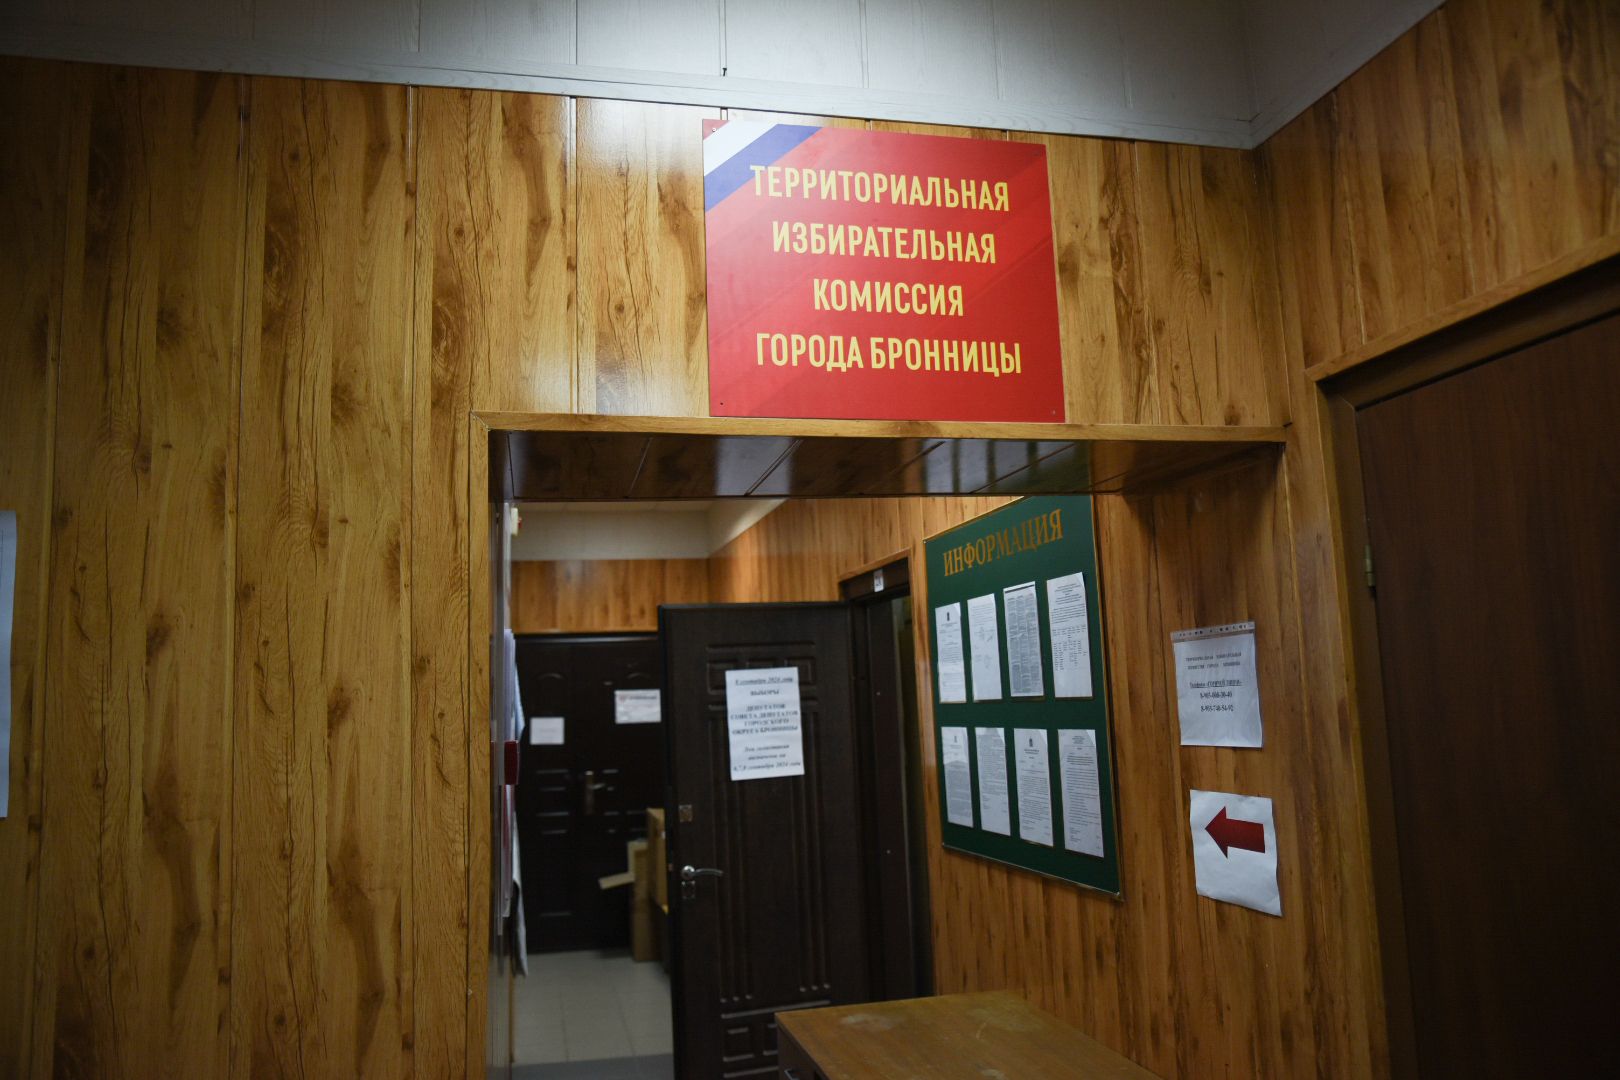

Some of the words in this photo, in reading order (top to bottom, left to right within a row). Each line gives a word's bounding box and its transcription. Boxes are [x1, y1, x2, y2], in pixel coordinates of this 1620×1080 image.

[749, 164, 1010, 212] ТЕРРИТОРИАЛЬНАЯ
[772, 220, 996, 264] ИЗБИРАТЕЛЬНАЯ
[812, 278, 964, 316] КОМИССИЯ
[756, 332, 864, 372] ГОРОДА
[870, 337, 1022, 377] БРОННИЦЫ
[943, 508, 1064, 577] ИНФОРМАЦИЯ
[746, 704, 786, 712] ДЕПУТАТОВ
